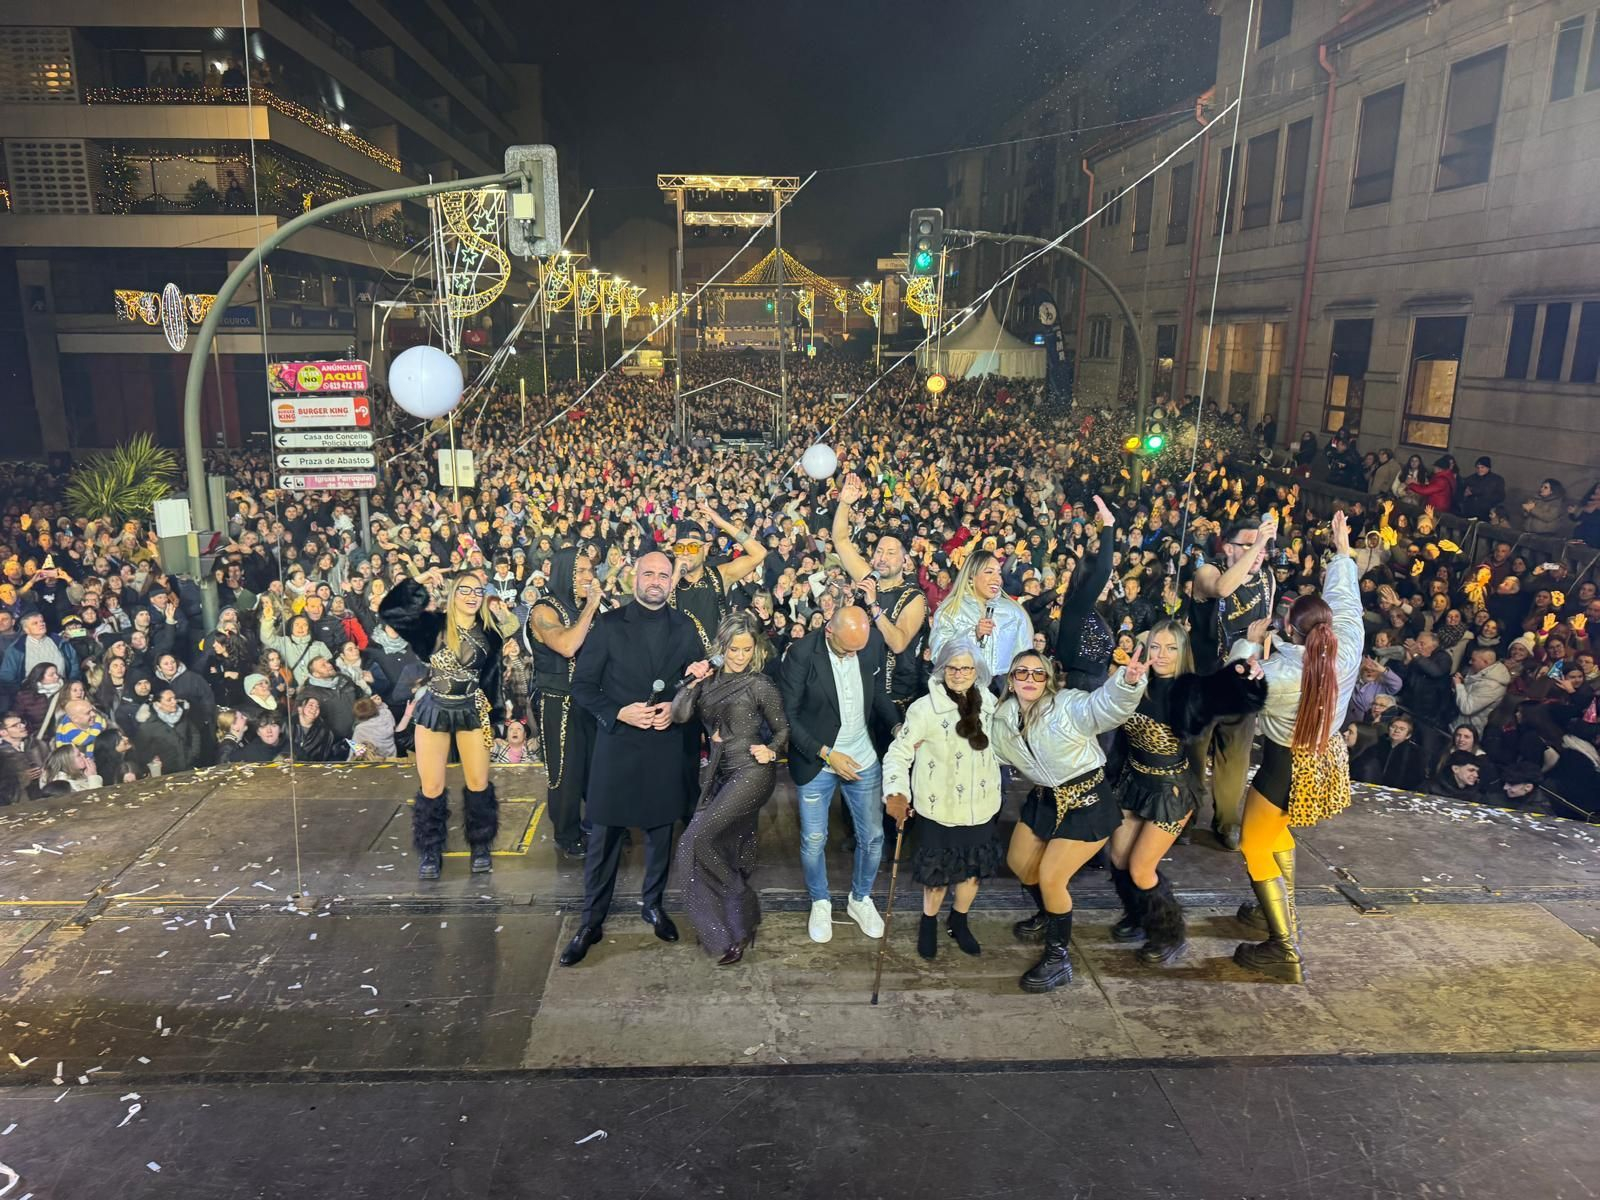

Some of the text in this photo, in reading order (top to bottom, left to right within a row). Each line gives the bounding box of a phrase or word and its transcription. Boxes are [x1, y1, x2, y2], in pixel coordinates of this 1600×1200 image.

[322, 364, 363, 372] ANÚNCIATE
[324, 372, 362, 381] AQUÍ
[298, 407, 329, 415] BURGER
[299, 456, 370, 465] Praza de Abastos
